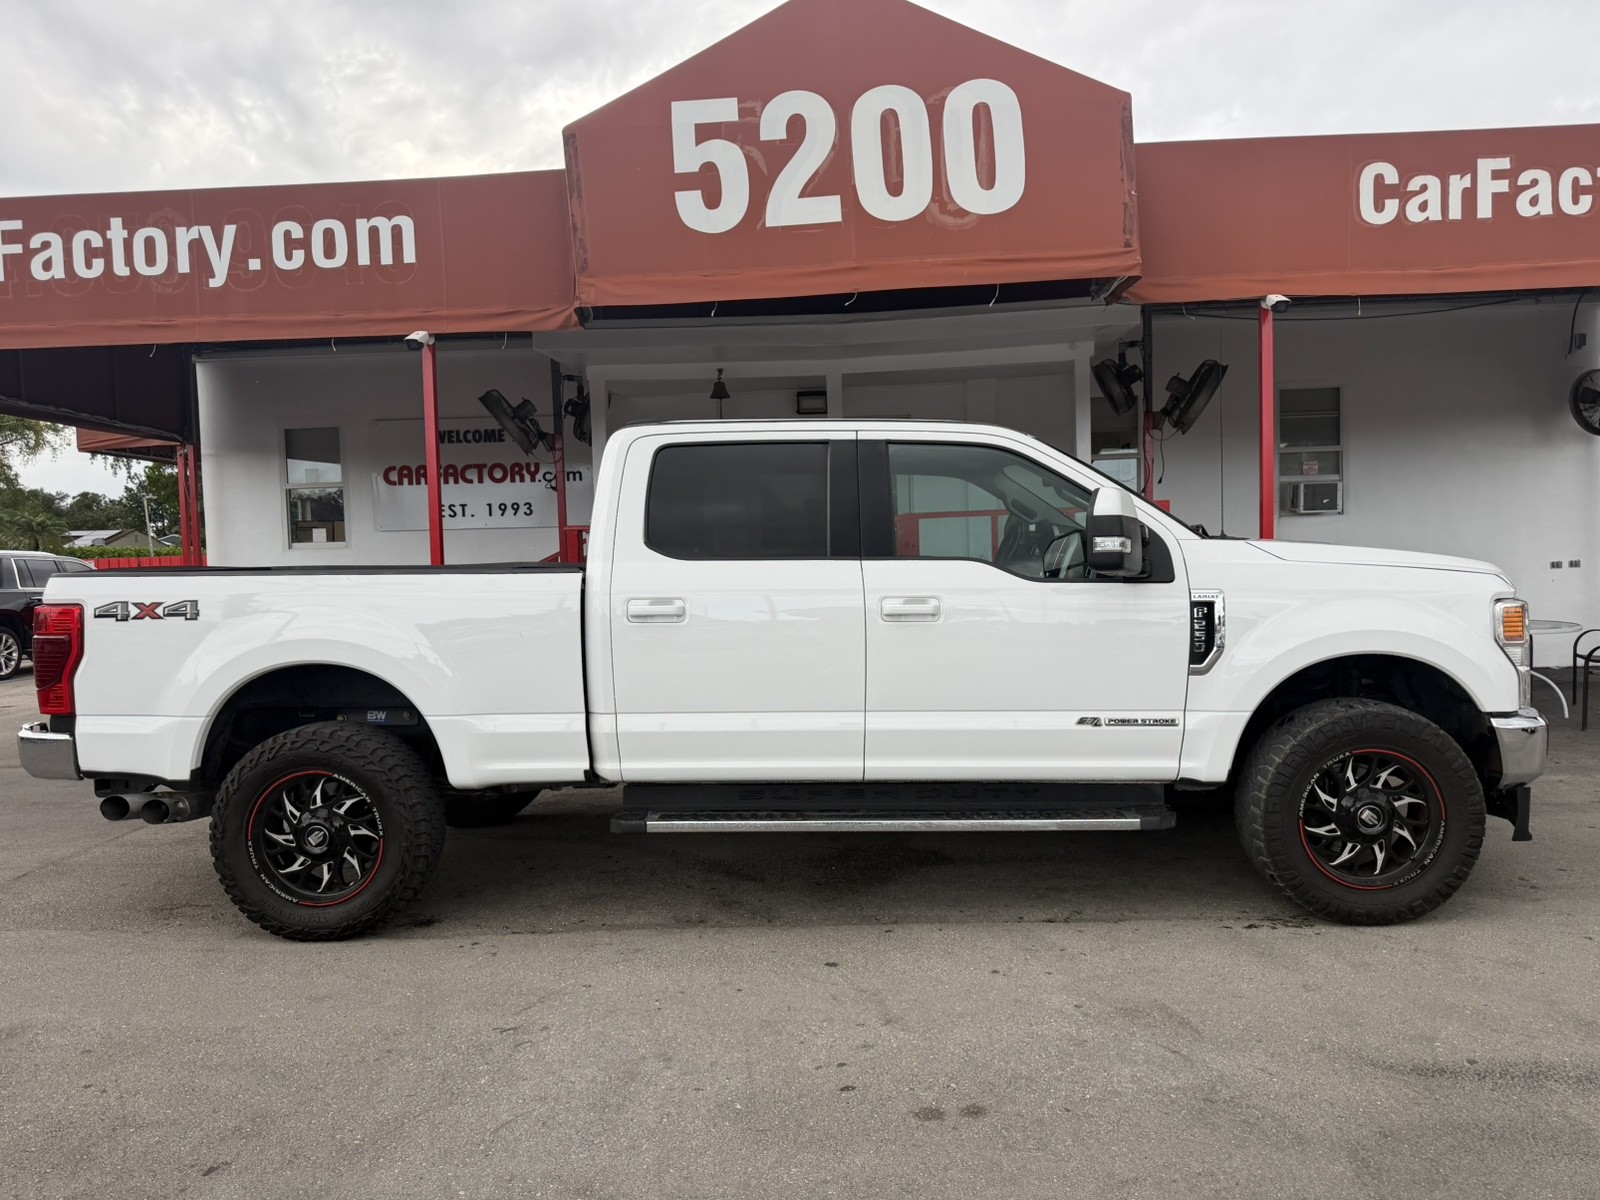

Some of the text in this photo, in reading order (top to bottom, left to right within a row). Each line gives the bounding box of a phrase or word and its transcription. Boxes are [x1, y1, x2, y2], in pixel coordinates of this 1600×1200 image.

[671, 78, 1026, 233] 5200
[1359, 157, 1600, 224] CarFac
[0, 213, 417, 288] Factory.com
[486, 501, 534, 517] 1993
[333, 773, 384, 836] AMERICAN TRUXX
[1299, 751, 1351, 817] AMERICAN TRUXX
[247, 840, 298, 903] AMERICAN TRUXX
[1393, 820, 1446, 886] AMERICAN TRUXX
